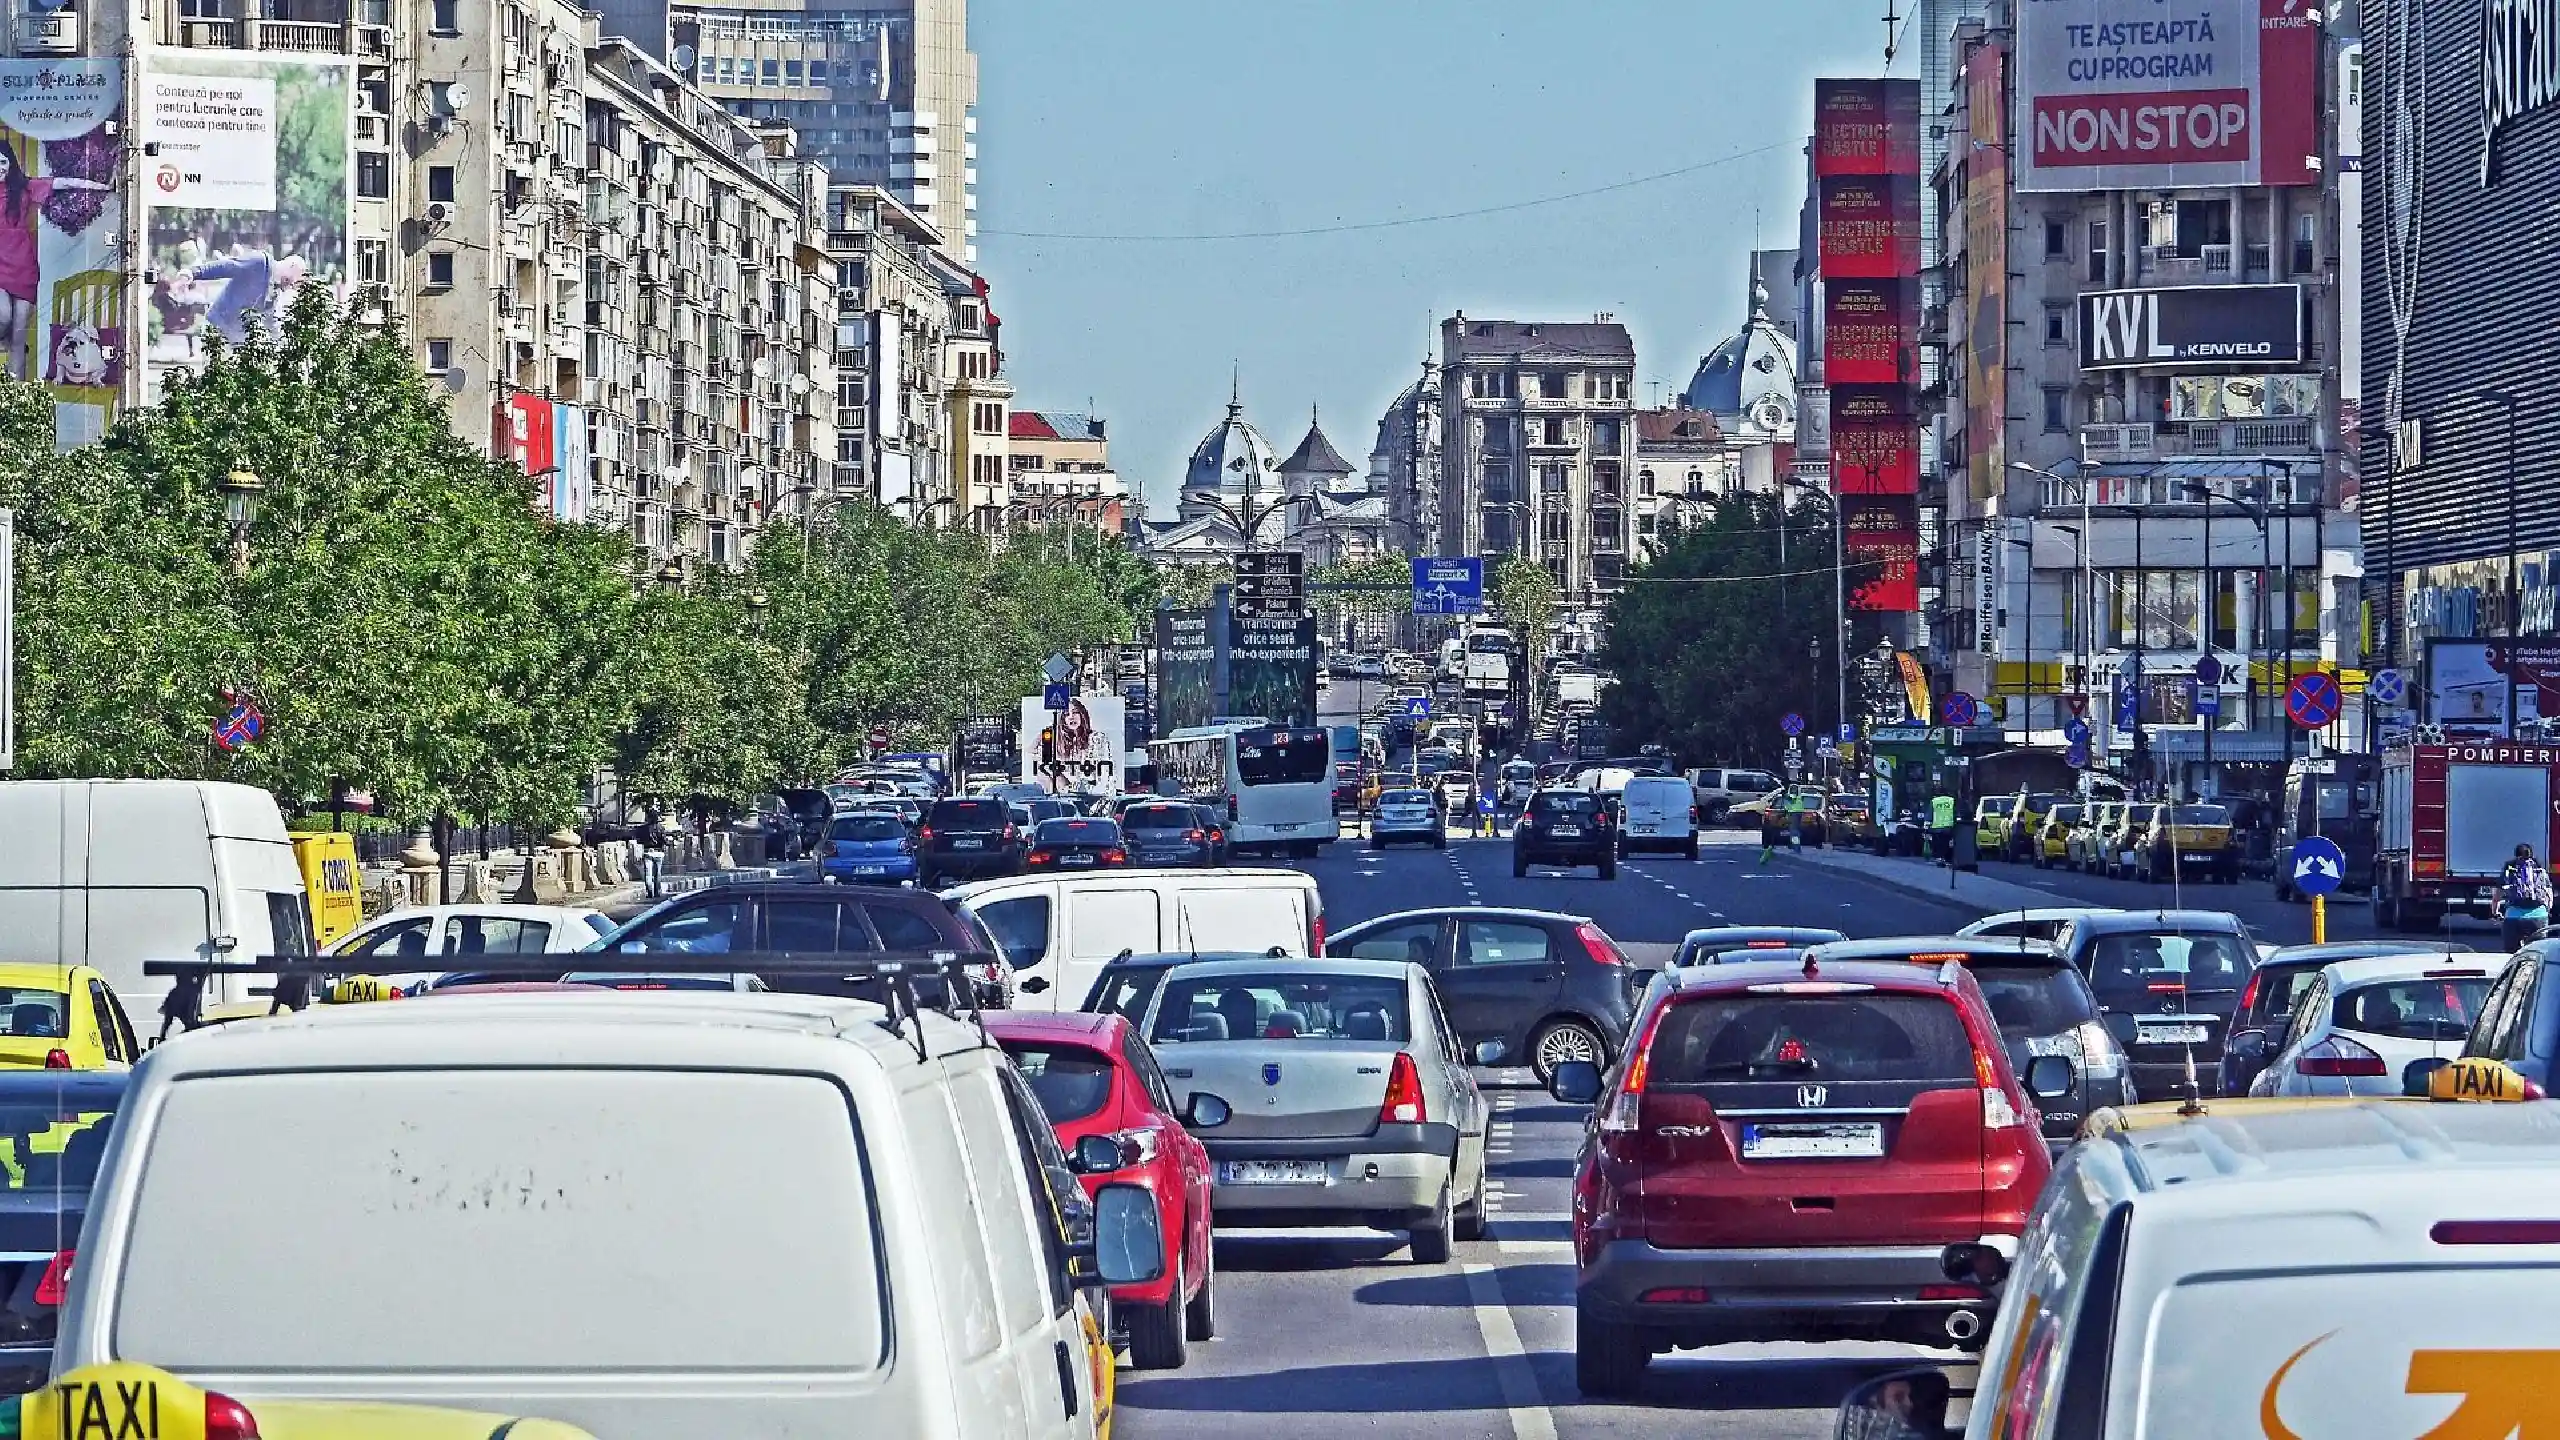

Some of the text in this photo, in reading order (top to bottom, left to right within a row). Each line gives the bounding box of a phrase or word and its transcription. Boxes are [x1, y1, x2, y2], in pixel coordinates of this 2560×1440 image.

[2261, 15, 2308, 29] INTRARE
[2066, 12, 2214, 55] TE AȘTEAPTĂ
[2068, 53, 2212, 81] CU PROGRAM
[156, 101, 263, 117] pentru lucrurile care
[208, 119, 243, 132] pentru
[245, 120, 266, 132] tine
[2037, 103, 2245, 152] NON STOP
[184, 173, 201, 183] NN
[2093, 294, 2174, 361] KVL
[2187, 342, 2271, 356] KENVELO
[1243, 631, 1295, 645] orice seară
[1841, 724, 1850, 740] P
[2448, 747, 2560, 762] POMPIERI
[345, 980, 378, 1001] TAXI
[2452, 1063, 2503, 1096] TAXI
[55, 1380, 159, 1440] TAXI
